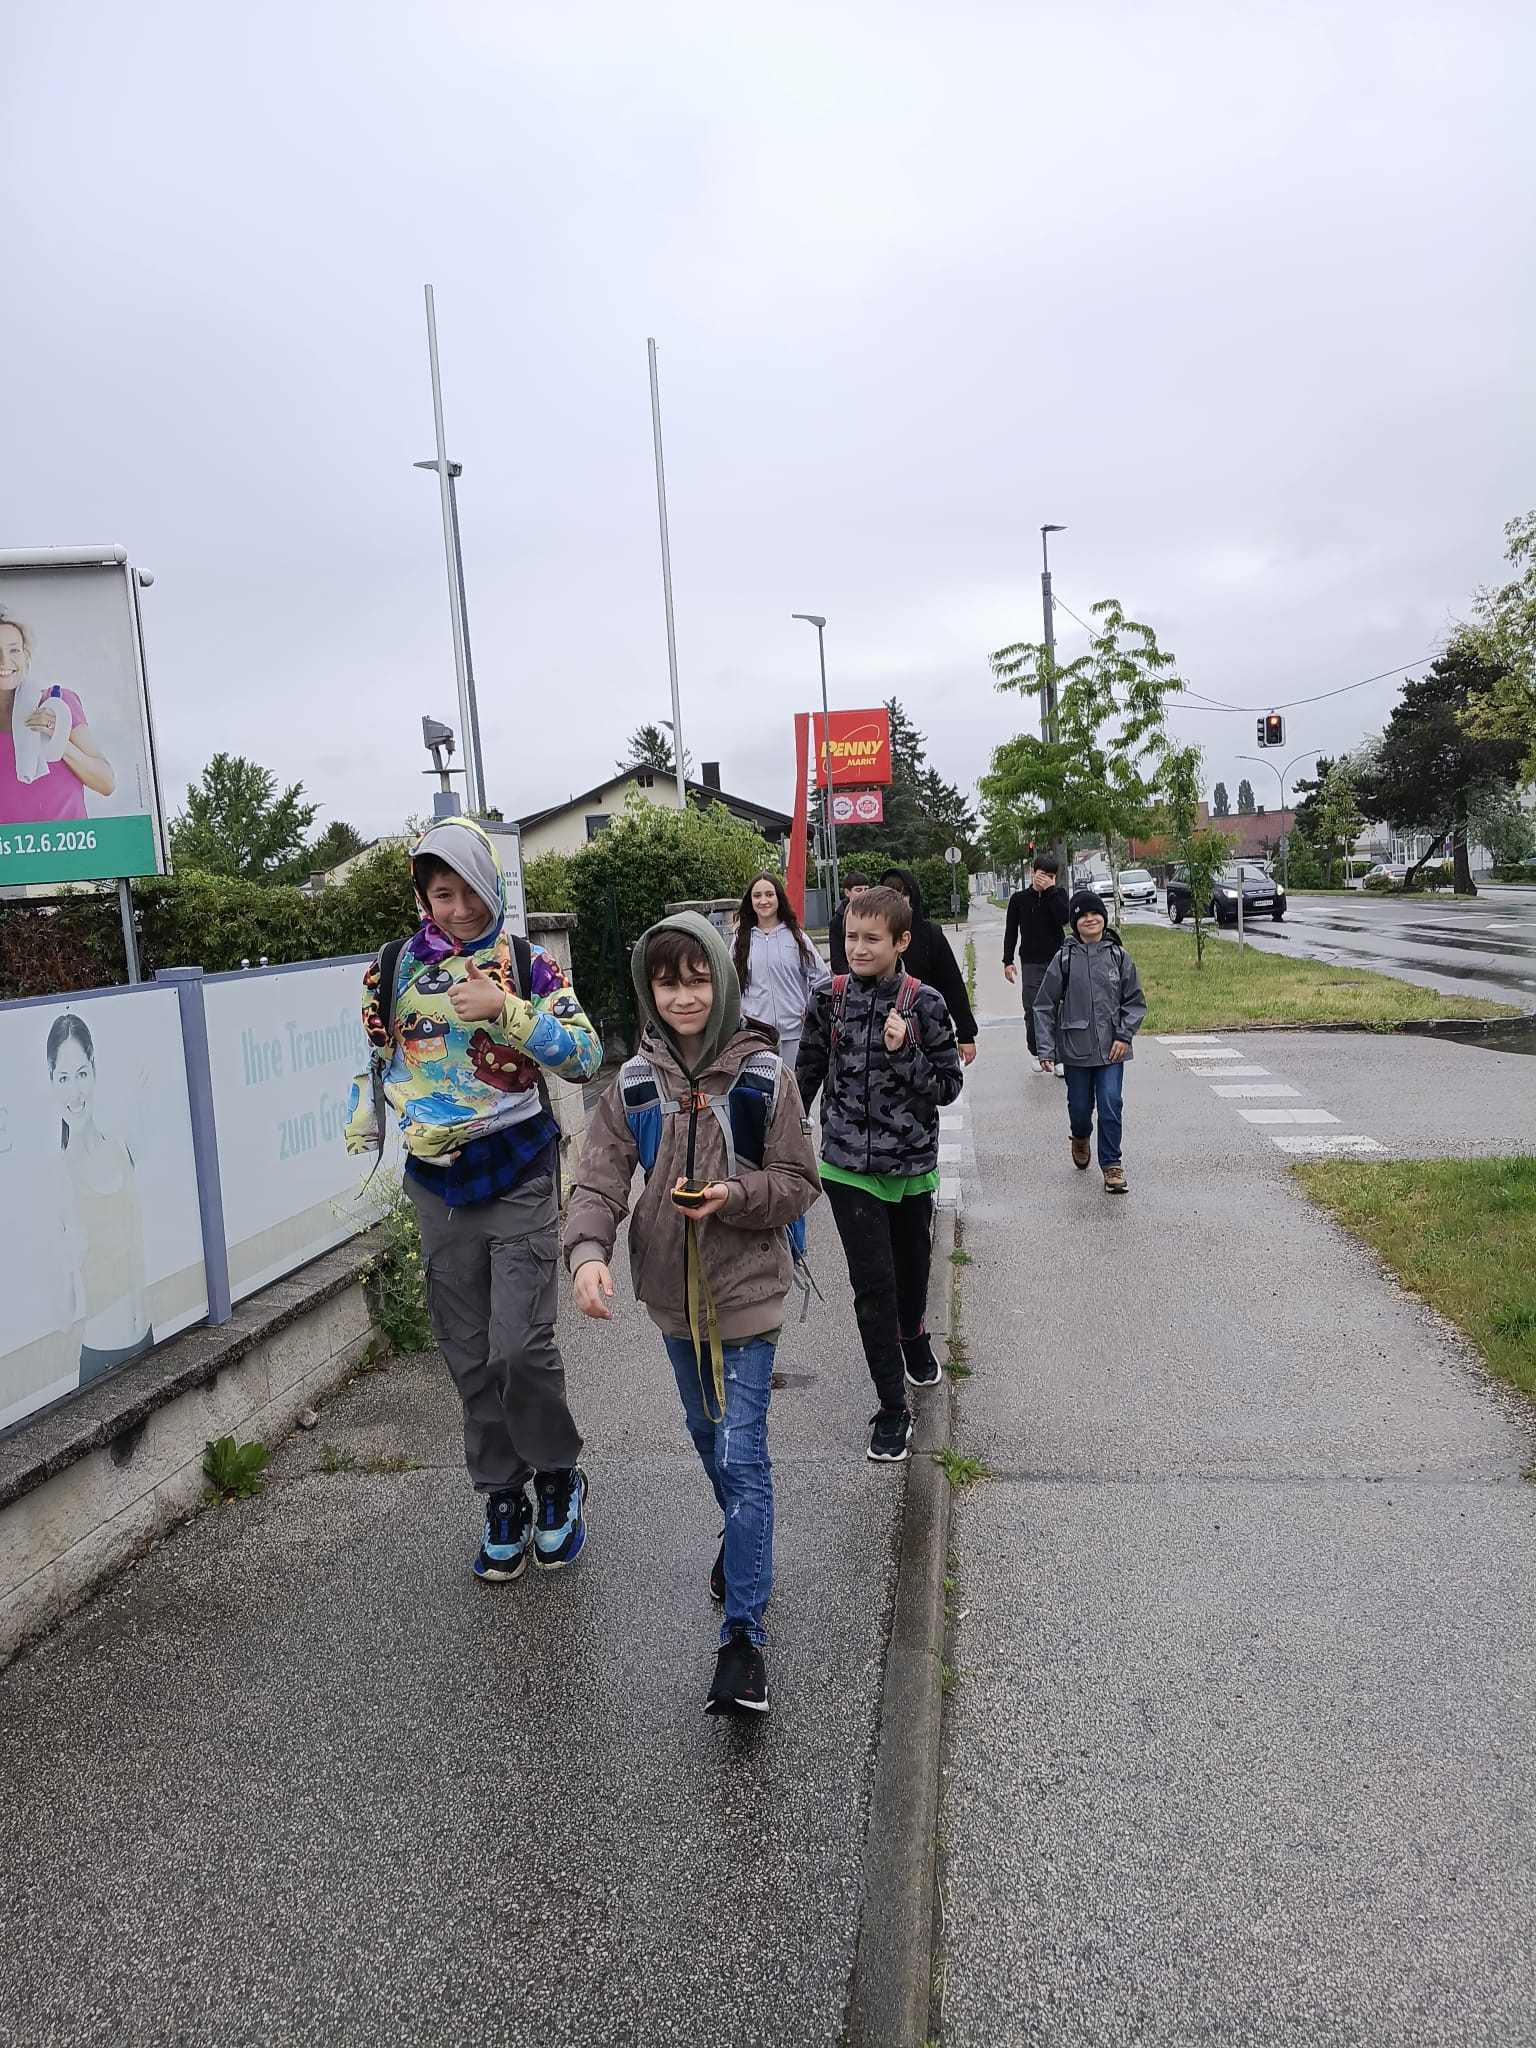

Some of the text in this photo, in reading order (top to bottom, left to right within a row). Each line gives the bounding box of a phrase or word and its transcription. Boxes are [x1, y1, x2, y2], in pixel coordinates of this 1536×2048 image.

[821, 740, 884, 758] PENNY
[847, 757, 877, 767] MARKT
[14, 830, 97, 854] 12.6.2026
[241, 1027, 284, 1086] Ihre
[277, 1085, 350, 1161] zum Gre
